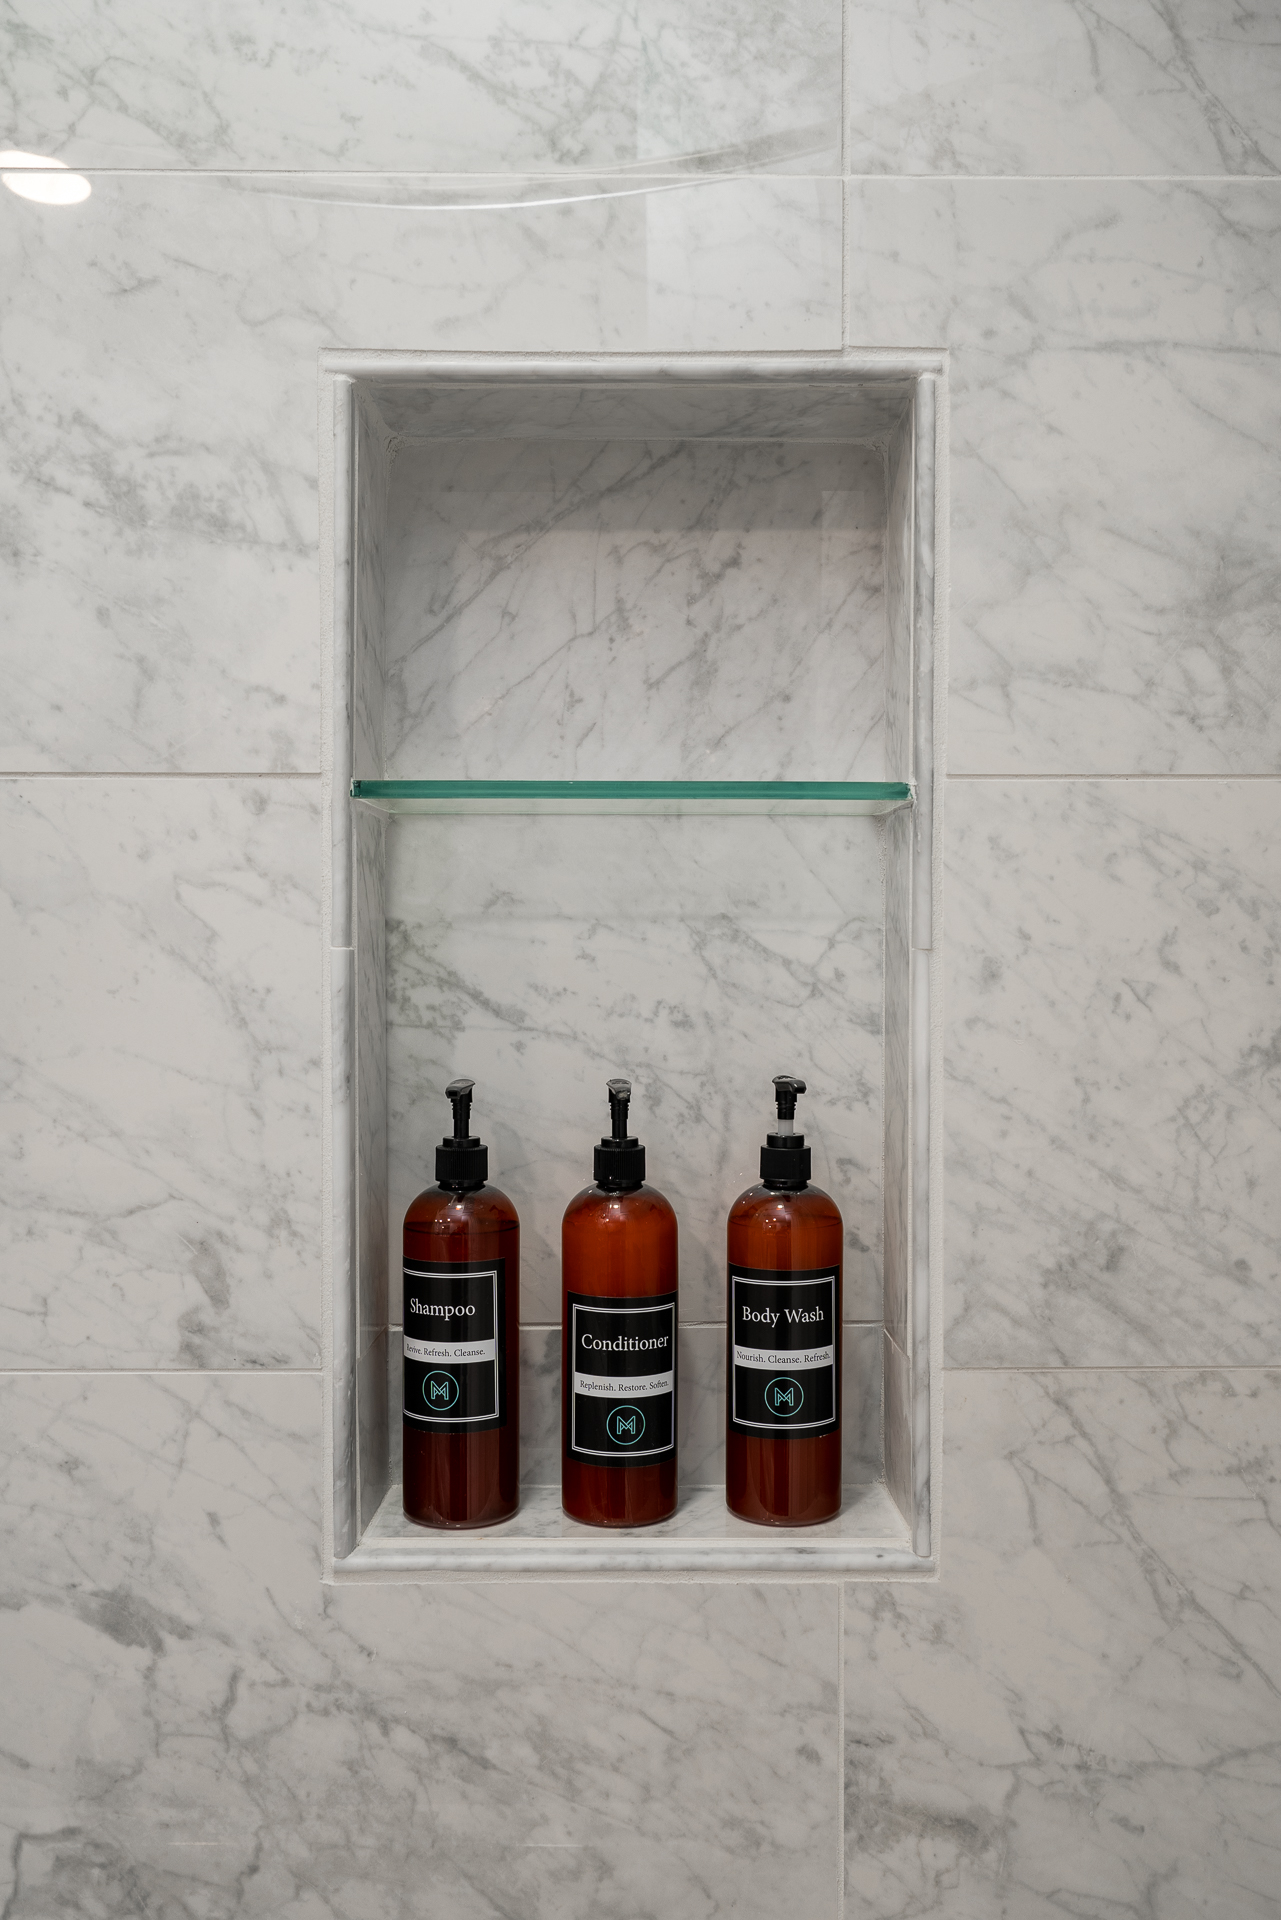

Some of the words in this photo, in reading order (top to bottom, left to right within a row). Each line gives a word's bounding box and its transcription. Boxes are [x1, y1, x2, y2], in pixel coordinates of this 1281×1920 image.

[410, 1298, 476, 1321] Shampoo
[742, 1306, 780, 1328] Body
[784, 1306, 824, 1323] Wash
[581, 1333, 669, 1351] Conditioner
[423, 1348, 452, 1357] Refresh.
[454, 1347, 486, 1357] Cleanse.
[736, 1350, 766, 1363] Nourish.
[767, 1354, 802, 1364] Cleanse.
[803, 1351, 831, 1363] Refresh.
[580, 1380, 616, 1392] Replenish.
[618, 1383, 648, 1392] Restore.
[649, 1380, 669, 1390] Soften.
